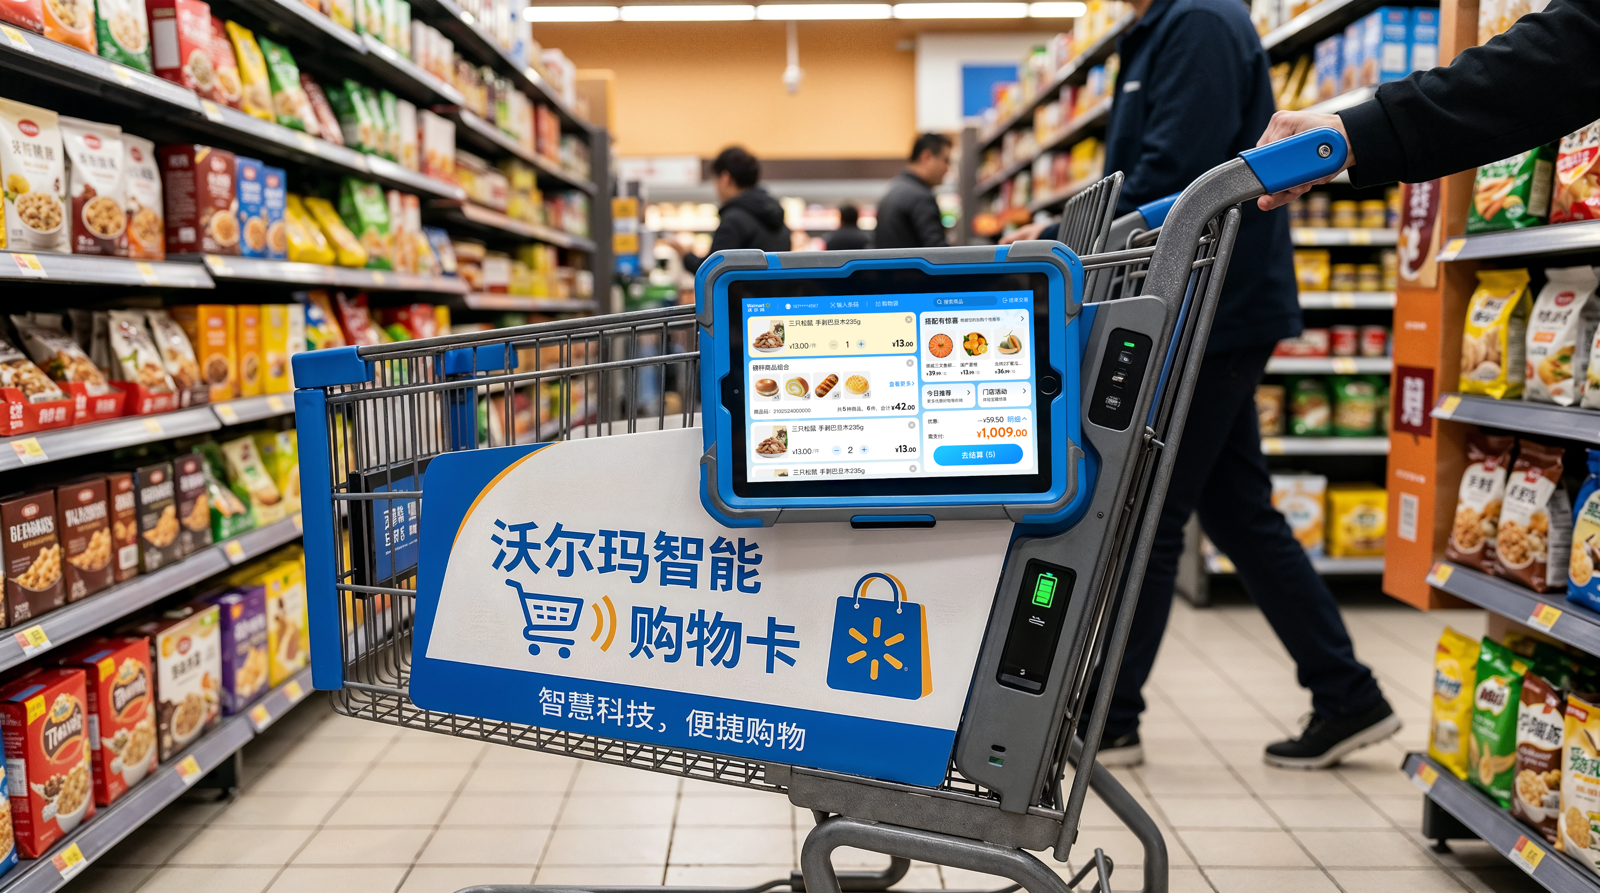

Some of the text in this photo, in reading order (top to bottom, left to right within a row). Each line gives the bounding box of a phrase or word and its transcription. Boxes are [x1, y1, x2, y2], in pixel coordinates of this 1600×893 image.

[924, 317, 959, 325] 搭配有惊喜
[892, 339, 914, 347] ¥13.00
[976, 427, 1028, 439] ¥1,009.00
[895, 444, 917, 453] ¥13.00
[961, 451, 996, 459] 去结算 (5)
[490, 518, 763, 594] 沃尔玛智能
[628, 604, 800, 674] 购物卡
[538, 686, 806, 752] 智慧科技，便捷购物
